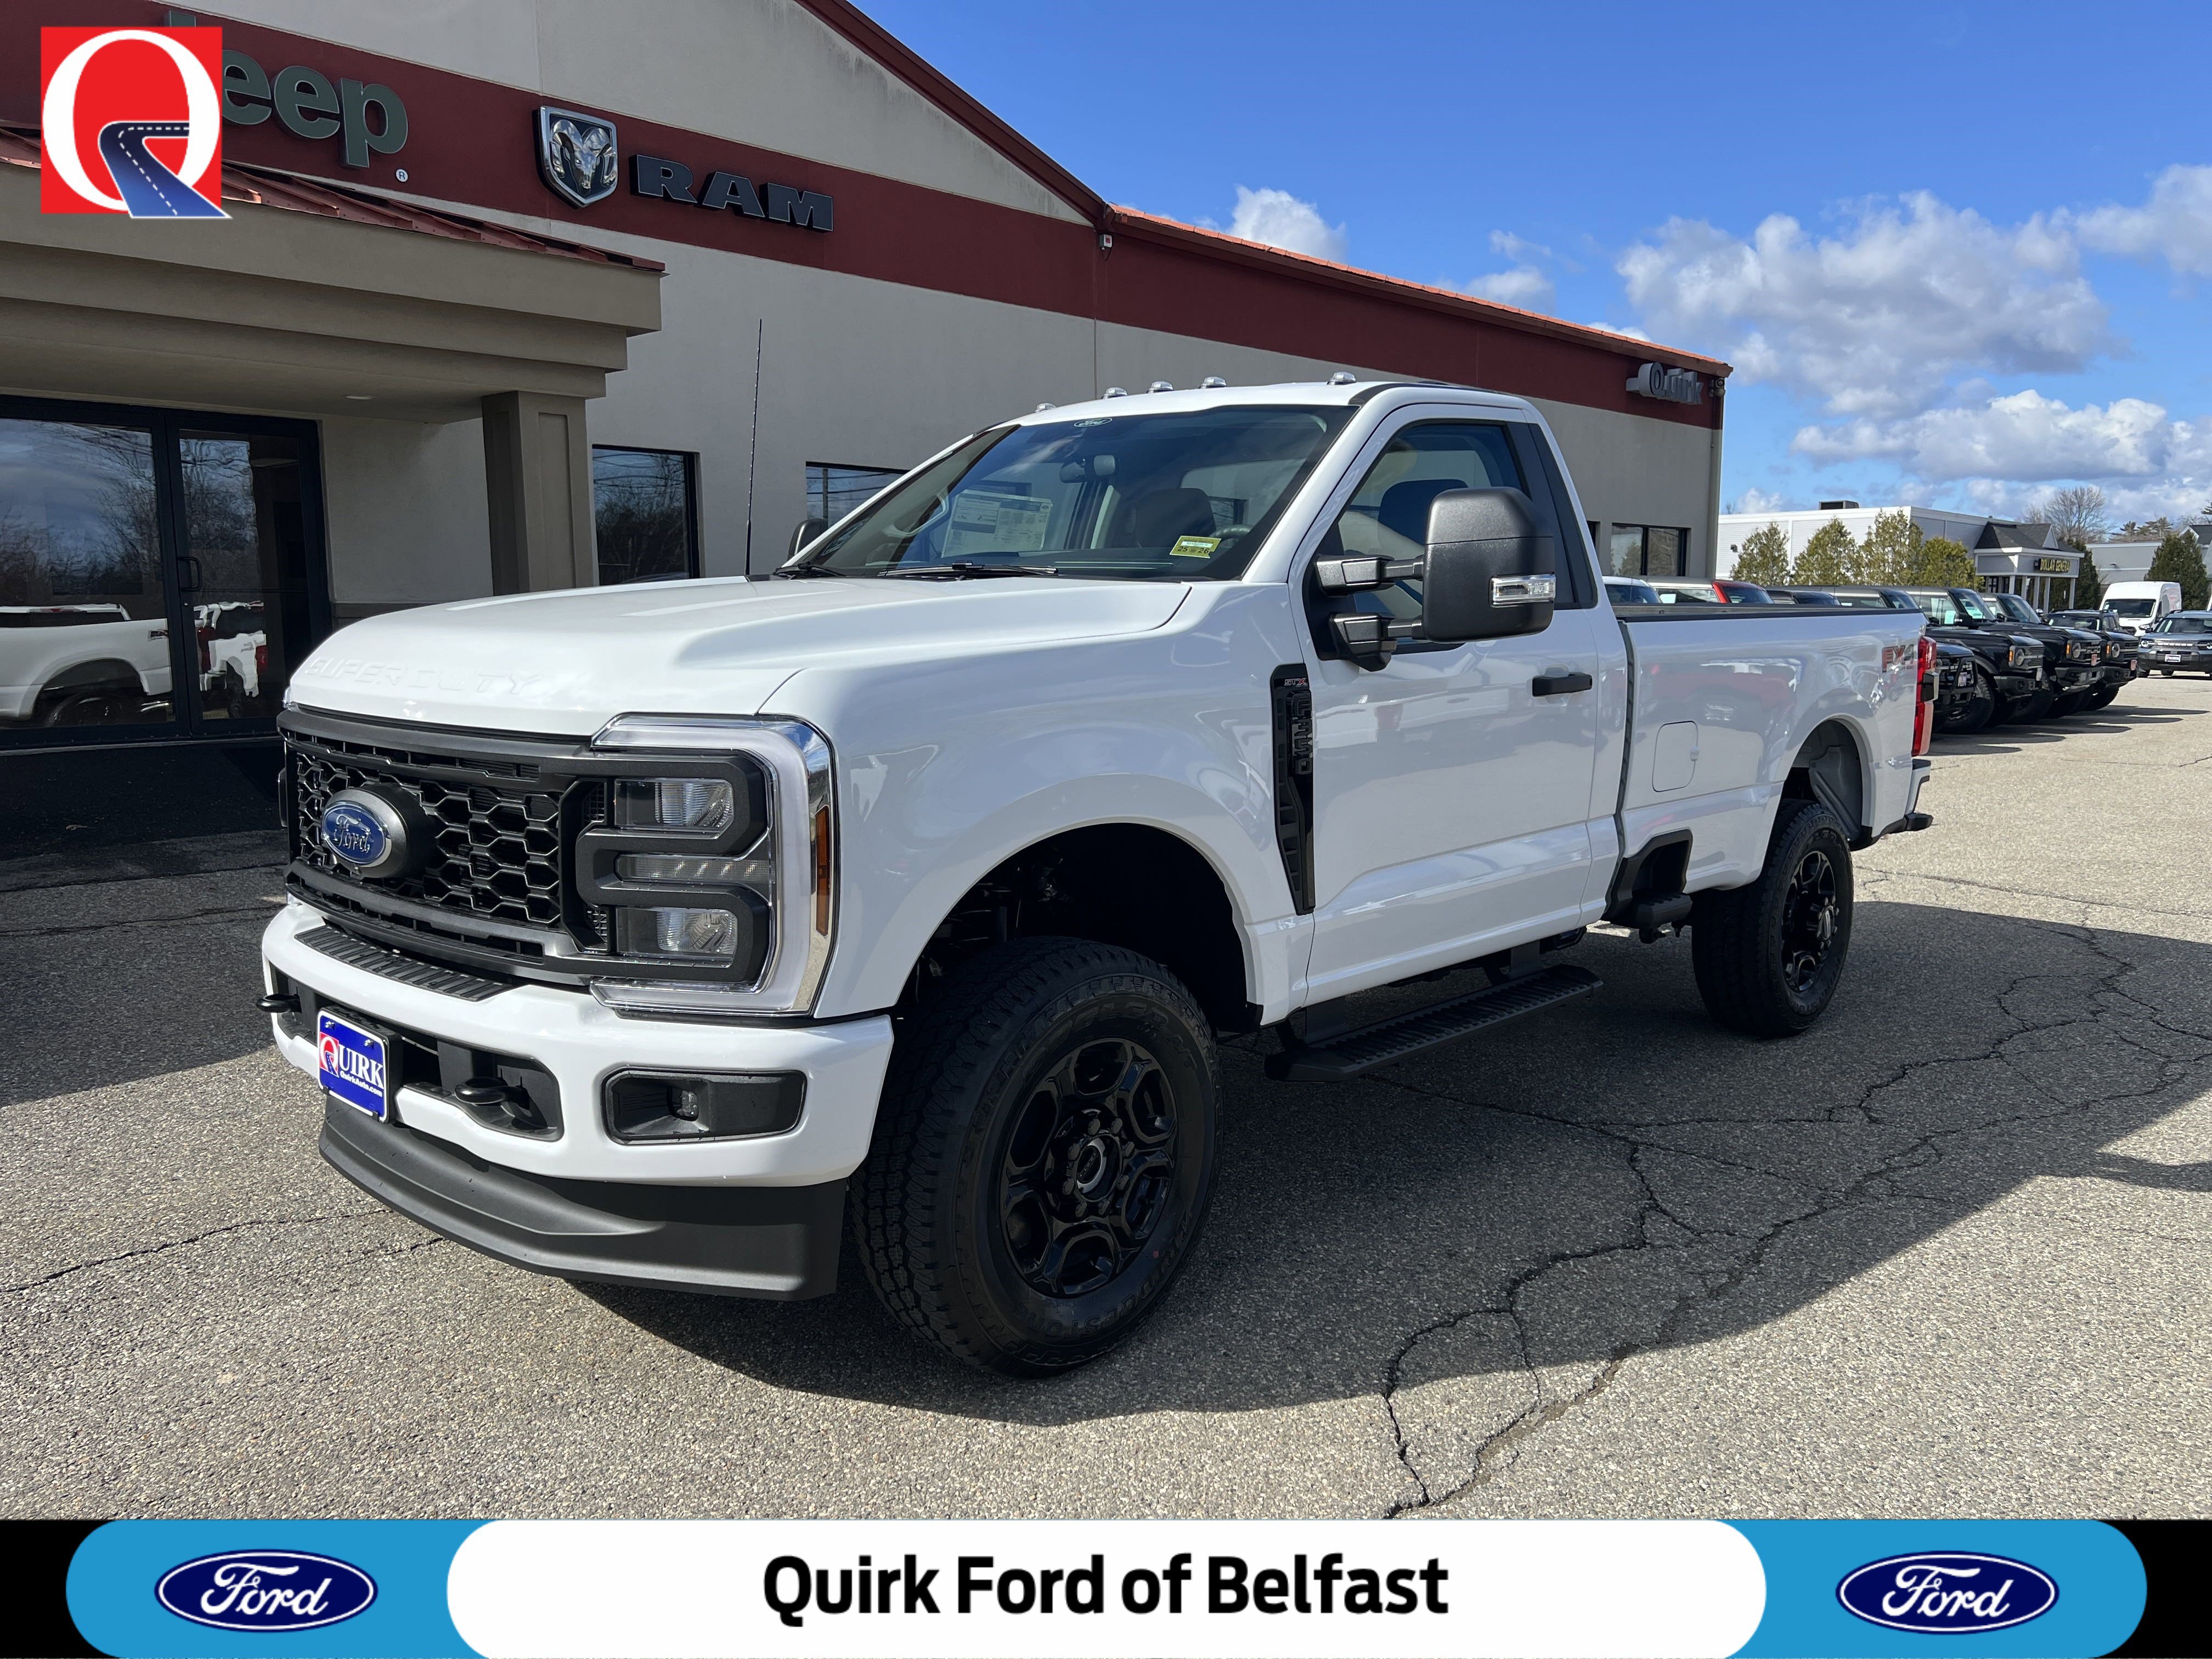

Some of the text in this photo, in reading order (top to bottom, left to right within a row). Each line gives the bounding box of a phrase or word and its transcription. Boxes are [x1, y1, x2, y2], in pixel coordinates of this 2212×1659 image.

[169, 10, 409, 167] eep
[635, 154, 834, 233] RAM
[2040, 558, 2055, 571] DOLLAR
[304, 657, 541, 695] SUPER DUTY
[1882, 644, 1914, 673] FX4
[1284, 678, 1308, 686] STX
[333, 814, 371, 854] Ford
[320, 1036, 385, 1090] QUIRK
[340, 1070, 382, 1098] QuirkAuto.com
